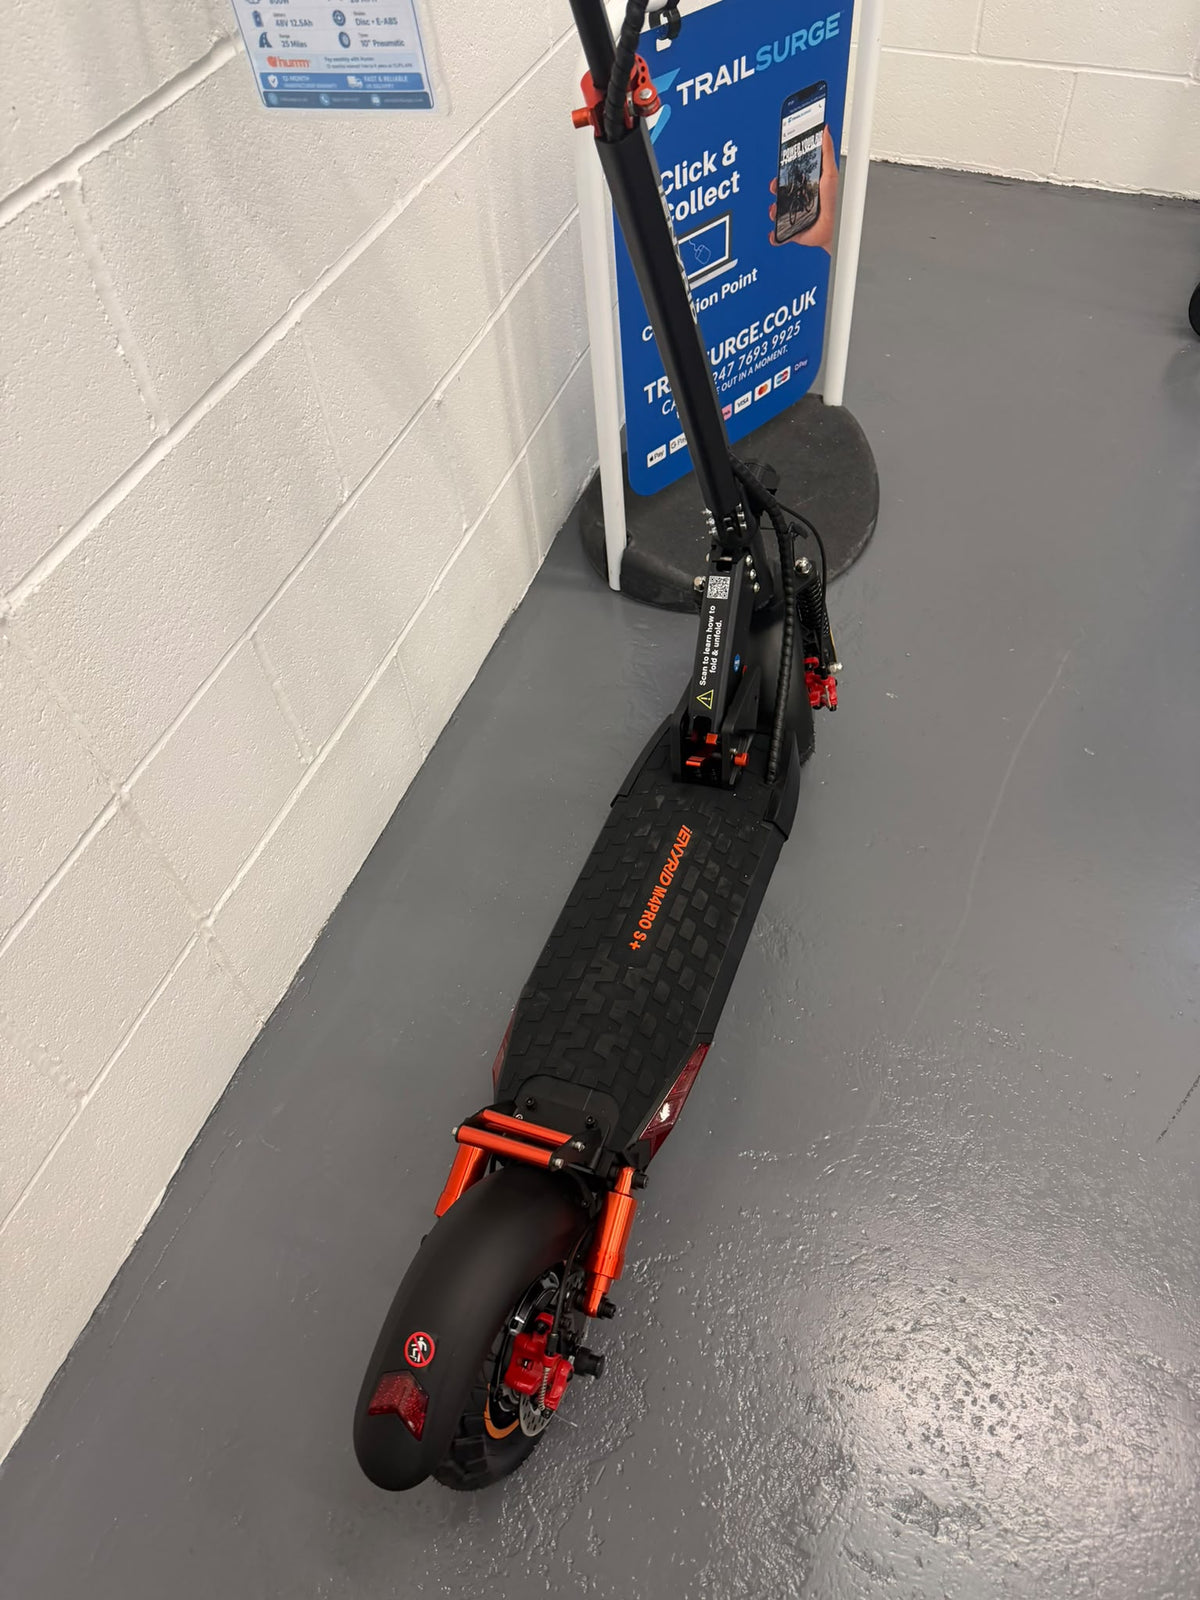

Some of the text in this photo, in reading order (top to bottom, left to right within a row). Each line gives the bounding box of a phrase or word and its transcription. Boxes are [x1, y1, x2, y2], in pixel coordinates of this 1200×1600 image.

[275, 19, 288, 27] 48V
[355, 18, 370, 26] Disc
[376, 17, 398, 25] E-ABS
[277, 56, 310, 68] humm
[281, 40, 307, 48] 25 Miles
[372, 39, 405, 47] Pneumatic
[676, 12, 841, 106] TRAILSURGE
[660, 150, 718, 195] Click
[721, 139, 738, 167] &
[721, 267, 758, 300] Point
[738, 341, 768, 371] 7693
[771, 320, 801, 350] 9925
[721, 375, 738, 392] OUT
[738, 369, 747, 382] IN
[747, 366, 754, 376] A
[754, 344, 788, 372] MOMENT.
[737, 397, 749, 408] VISA
[699, 605, 716, 686] Scan to learn how to
[709, 658, 717, 673] fold
[713, 620, 722, 648] unfold.
[638, 885, 667, 930] M4PRO
